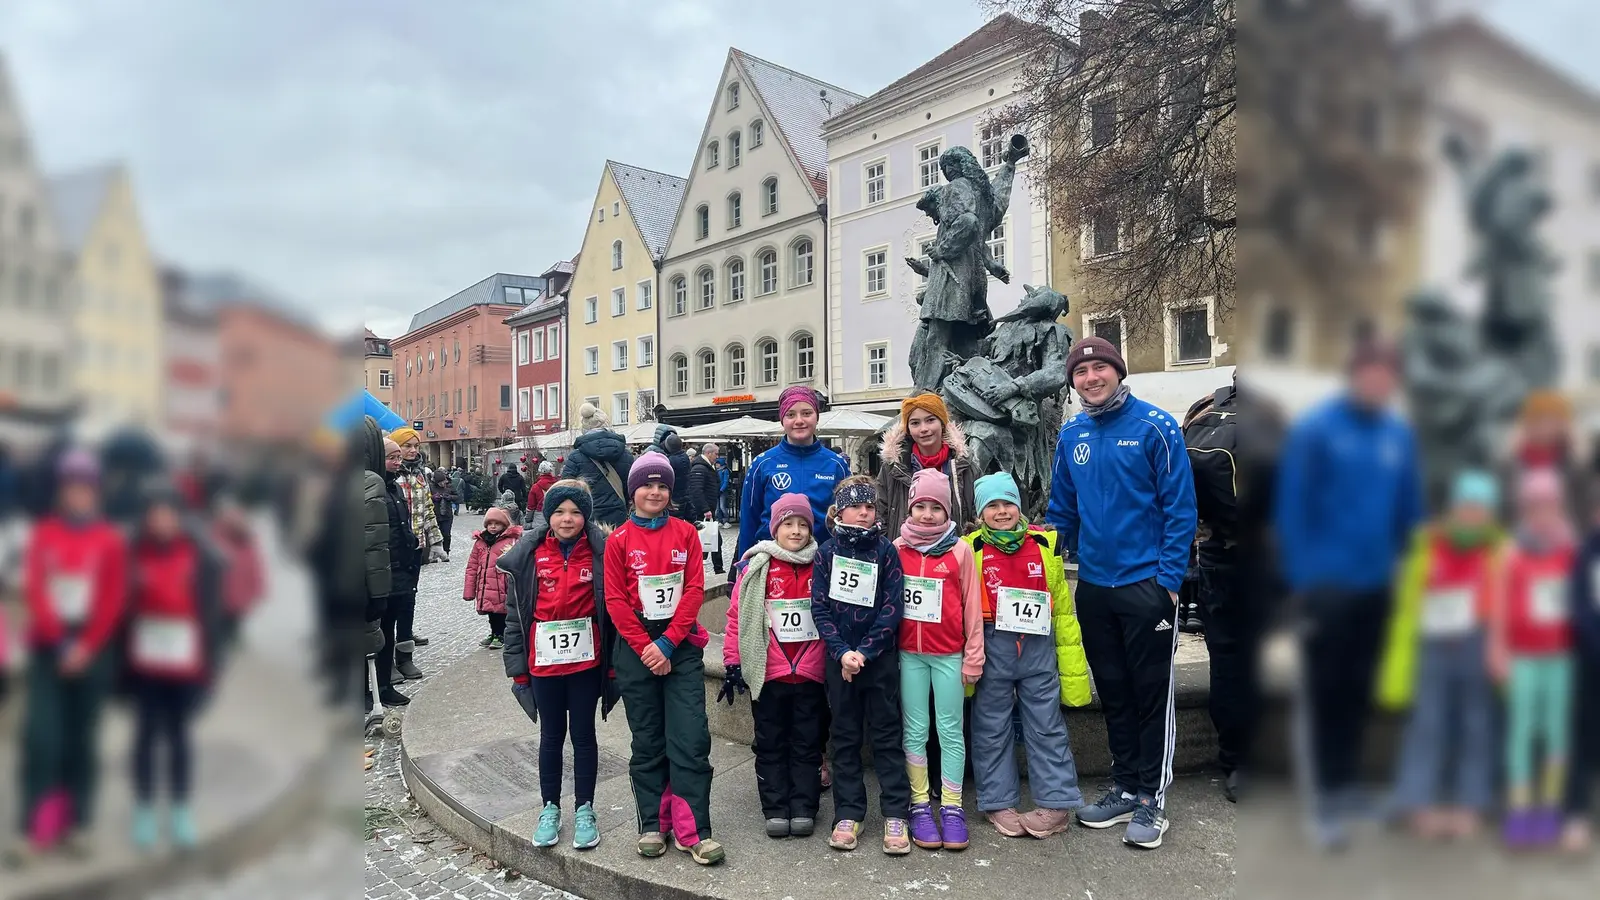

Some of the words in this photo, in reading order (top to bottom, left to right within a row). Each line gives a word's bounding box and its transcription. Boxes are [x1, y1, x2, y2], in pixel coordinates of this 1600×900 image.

[838, 571, 859, 588] 35
[655, 587, 674, 604] 37
[904, 588, 923, 606] 36
[1012, 602, 1042, 619] 147
[781, 612, 801, 627] 70
[548, 632, 580, 650] 137
